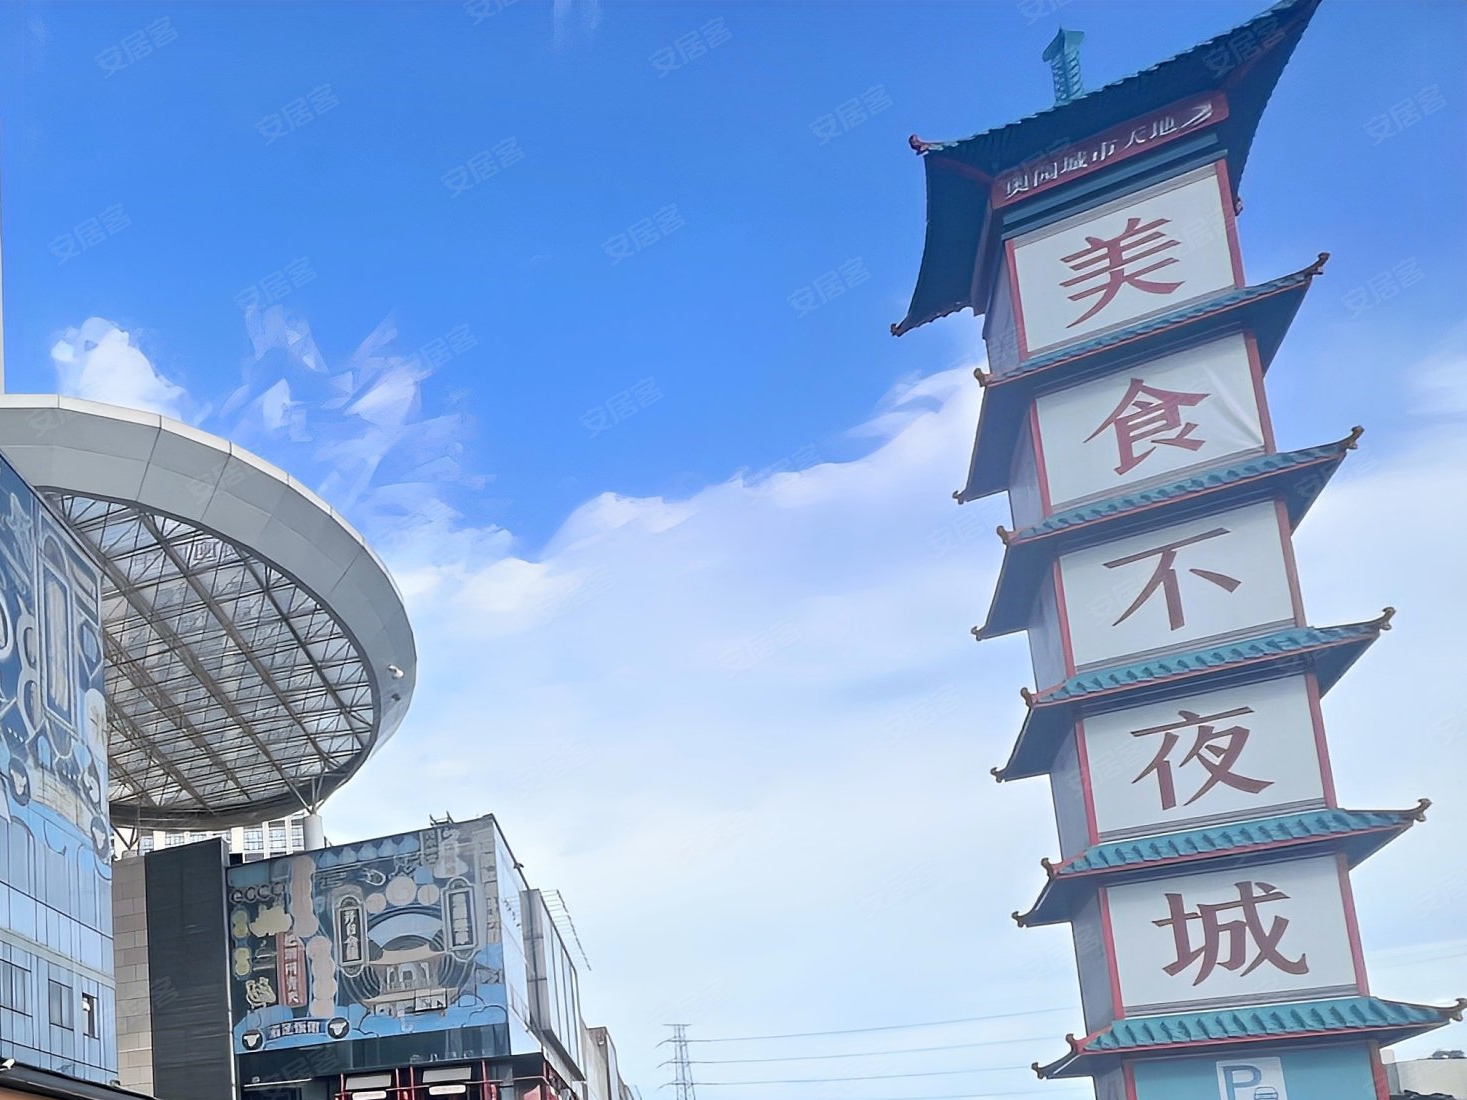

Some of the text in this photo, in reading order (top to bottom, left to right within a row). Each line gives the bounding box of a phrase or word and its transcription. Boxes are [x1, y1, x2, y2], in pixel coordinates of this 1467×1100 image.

[1059, 217, 1309, 987] 美食不夜城
